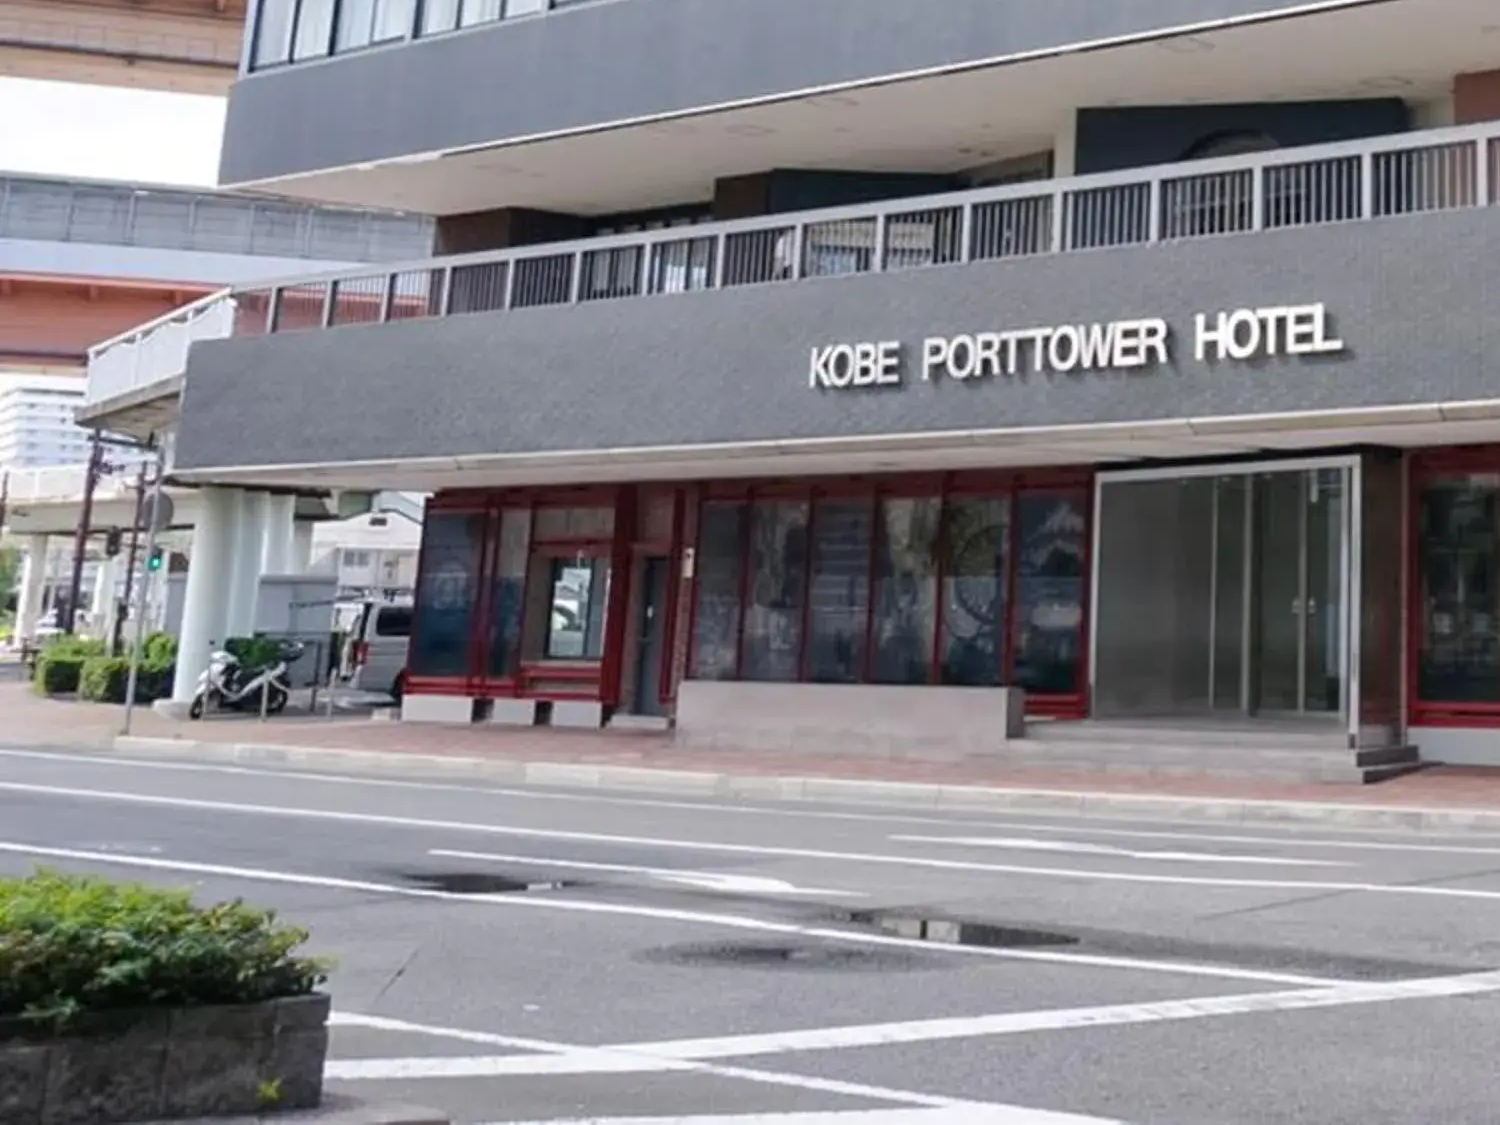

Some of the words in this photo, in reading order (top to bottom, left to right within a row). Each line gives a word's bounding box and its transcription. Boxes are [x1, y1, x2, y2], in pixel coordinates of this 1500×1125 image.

[809, 340, 899, 389] KOBE
[922, 317, 1168, 382] PORTTOWER
[1194, 302, 1342, 362] HOTEL
